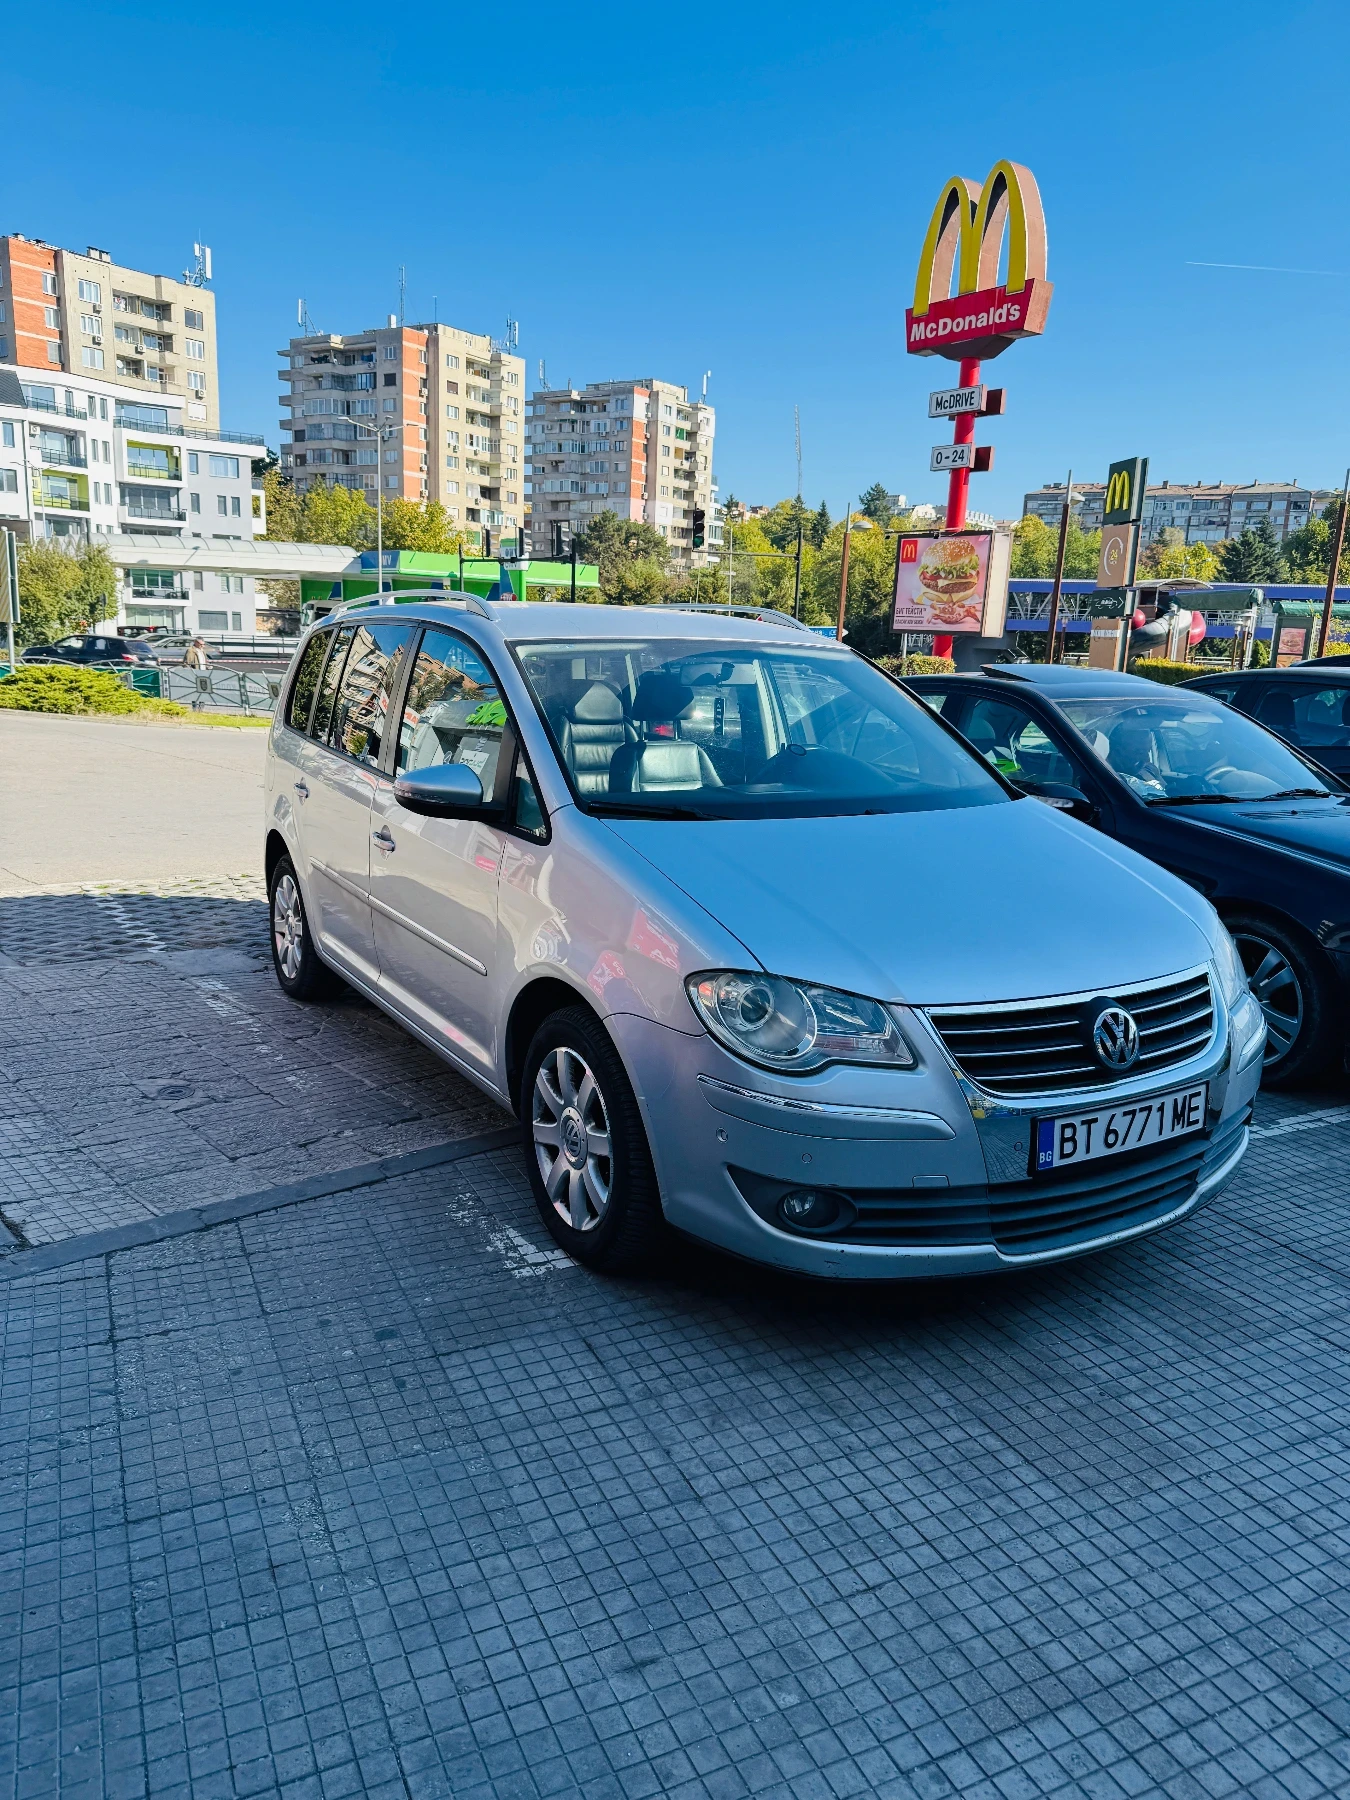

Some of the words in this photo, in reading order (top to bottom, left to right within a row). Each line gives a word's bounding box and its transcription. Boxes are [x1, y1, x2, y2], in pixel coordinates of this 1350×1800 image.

[910, 303, 1021, 342] McDonald's
[935, 390, 975, 411] McDRIVE
[381, 554, 392, 566] MV
[1039, 1151, 1053, 1164] BG
